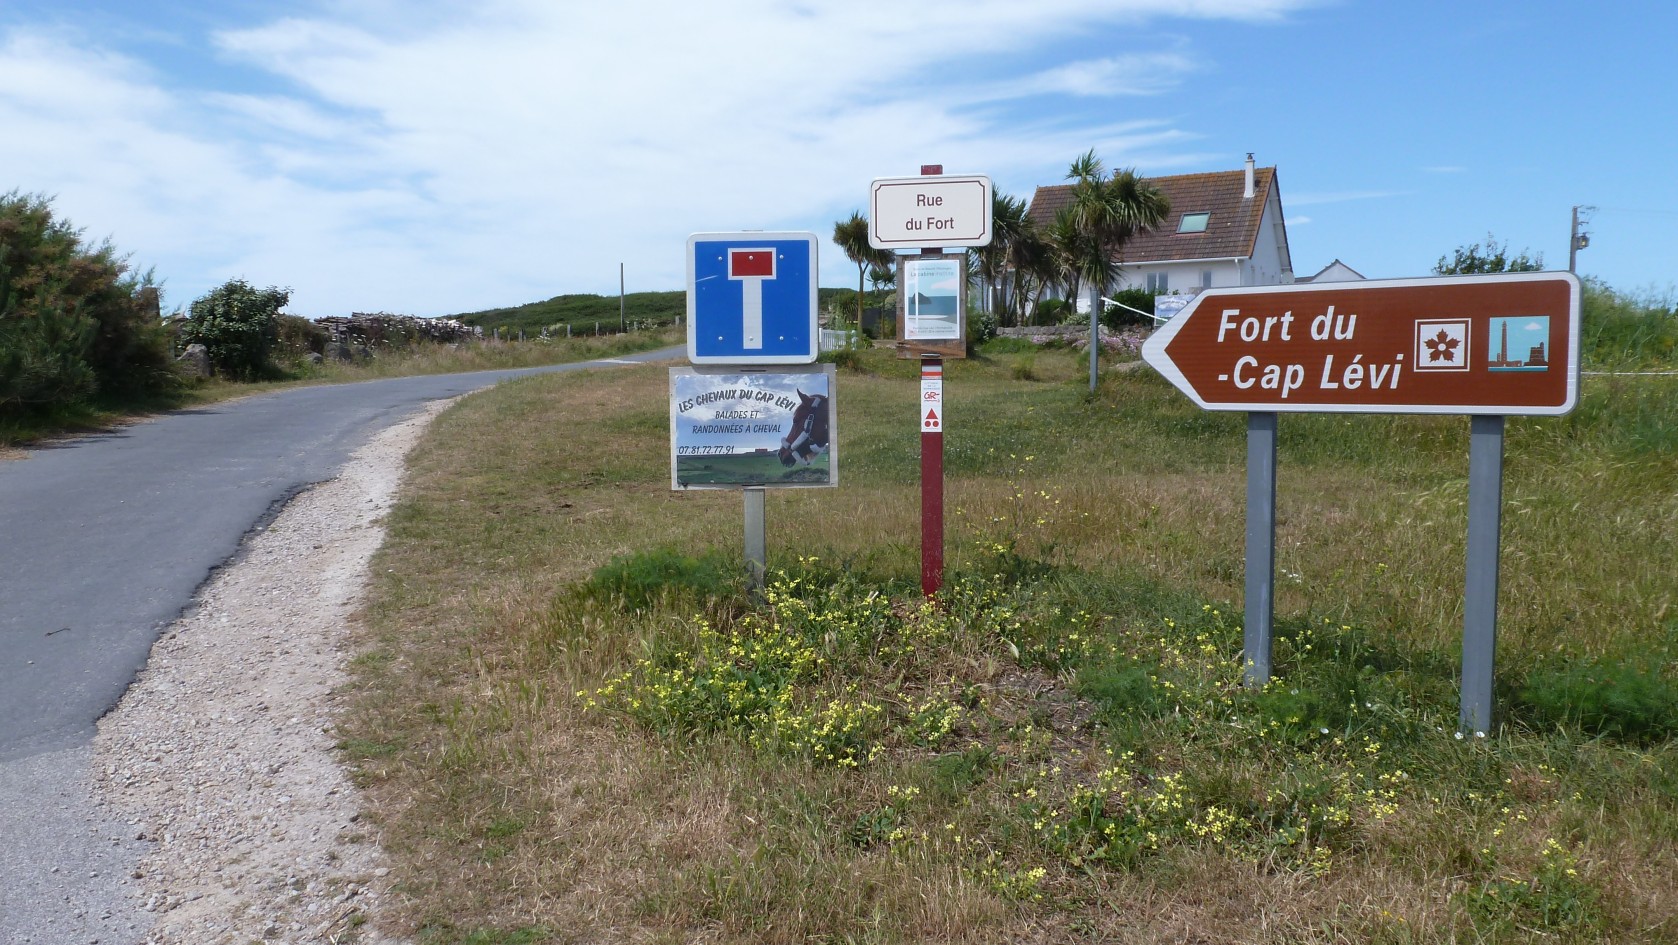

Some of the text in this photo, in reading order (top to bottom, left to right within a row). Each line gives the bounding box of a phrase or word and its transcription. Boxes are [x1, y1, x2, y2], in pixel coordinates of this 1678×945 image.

[916, 194, 943, 207] Rue
[905, 217, 955, 231] du Fort
[1217, 305, 1357, 343] Fort du
[1320, 354, 1404, 390] Lévi
[678, 389, 797, 413] LES CHEVAUX DU CAP LÉVI
[715, 410, 759, 420] BALADES ET
[692, 422, 744, 434] RANDONNÉES
[753, 423, 782, 433] CHEVAL
[678, 445, 735, 455] 07.81.72.77.91
